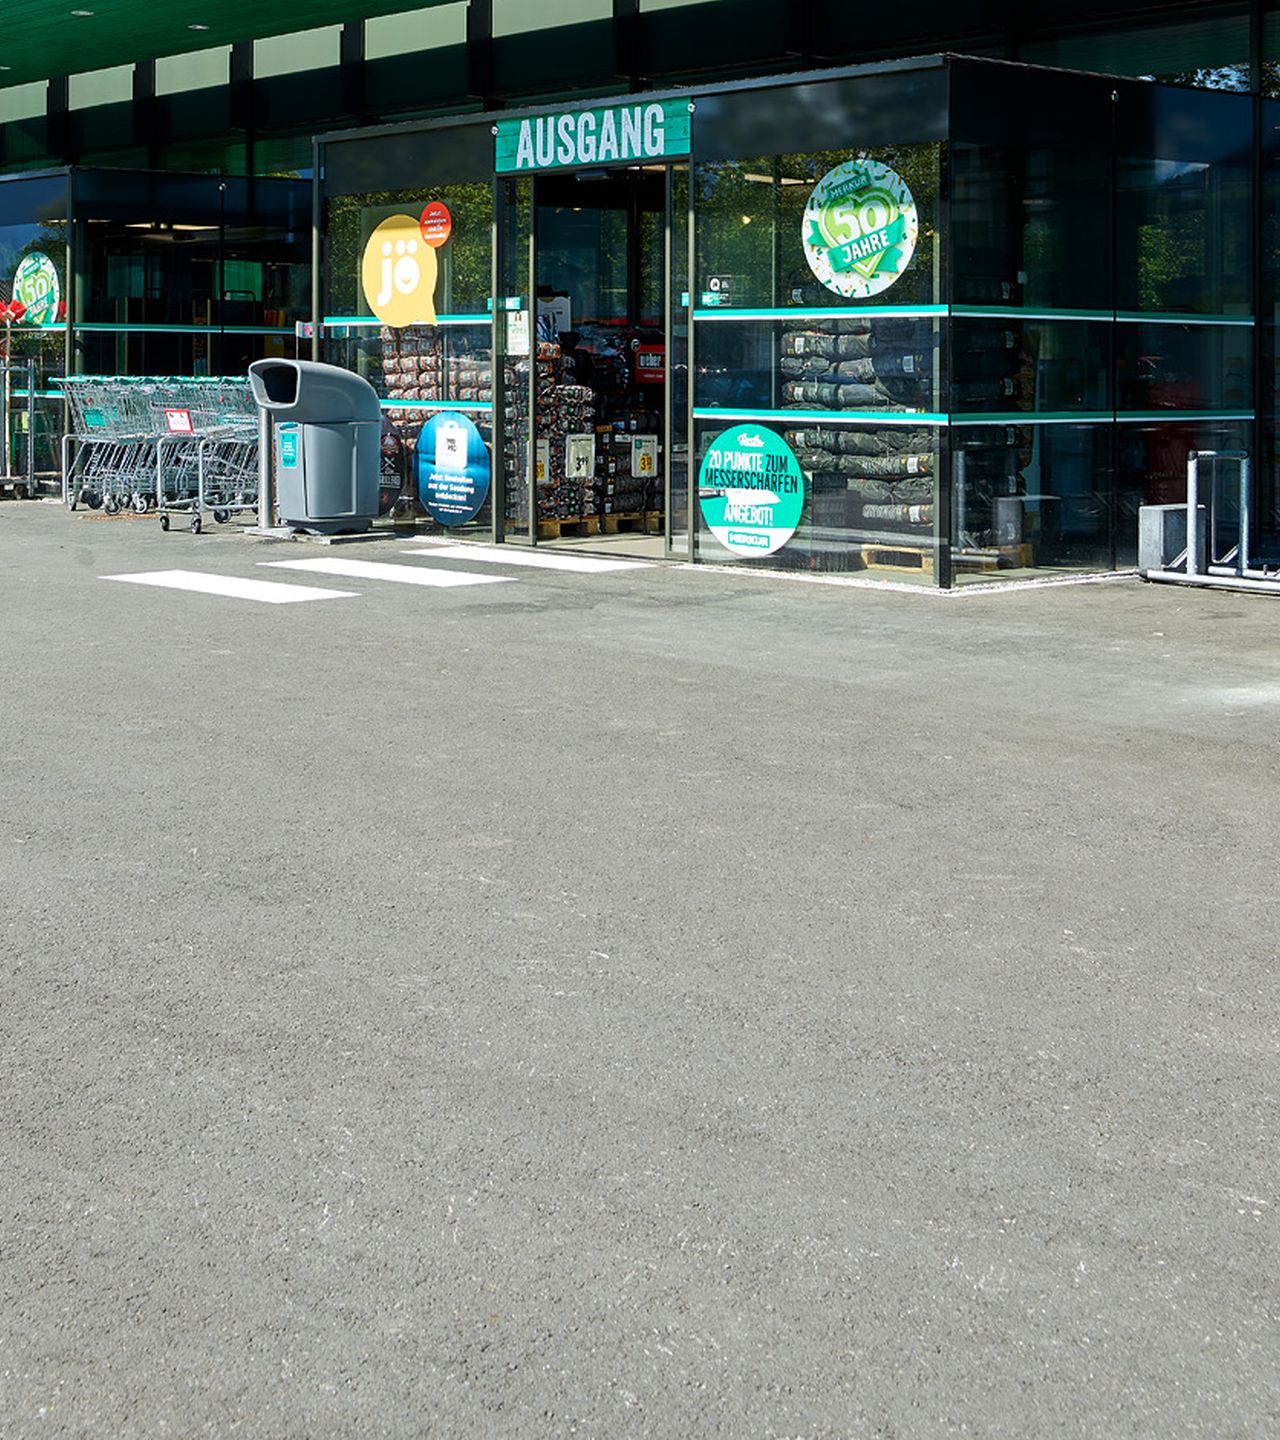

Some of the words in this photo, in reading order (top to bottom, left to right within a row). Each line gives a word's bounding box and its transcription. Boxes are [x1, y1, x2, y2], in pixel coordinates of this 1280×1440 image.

[515, 103, 666, 169] AUSGANG
[832, 199, 889, 244] 50
[841, 229, 890, 263] JAHRE
[376, 239, 420, 308] jö
[708, 449, 723, 469] 20
[723, 451, 764, 472] PUNKTE
[765, 453, 789, 474] ZUM
[723, 503, 774, 527] ANGEBOT!
